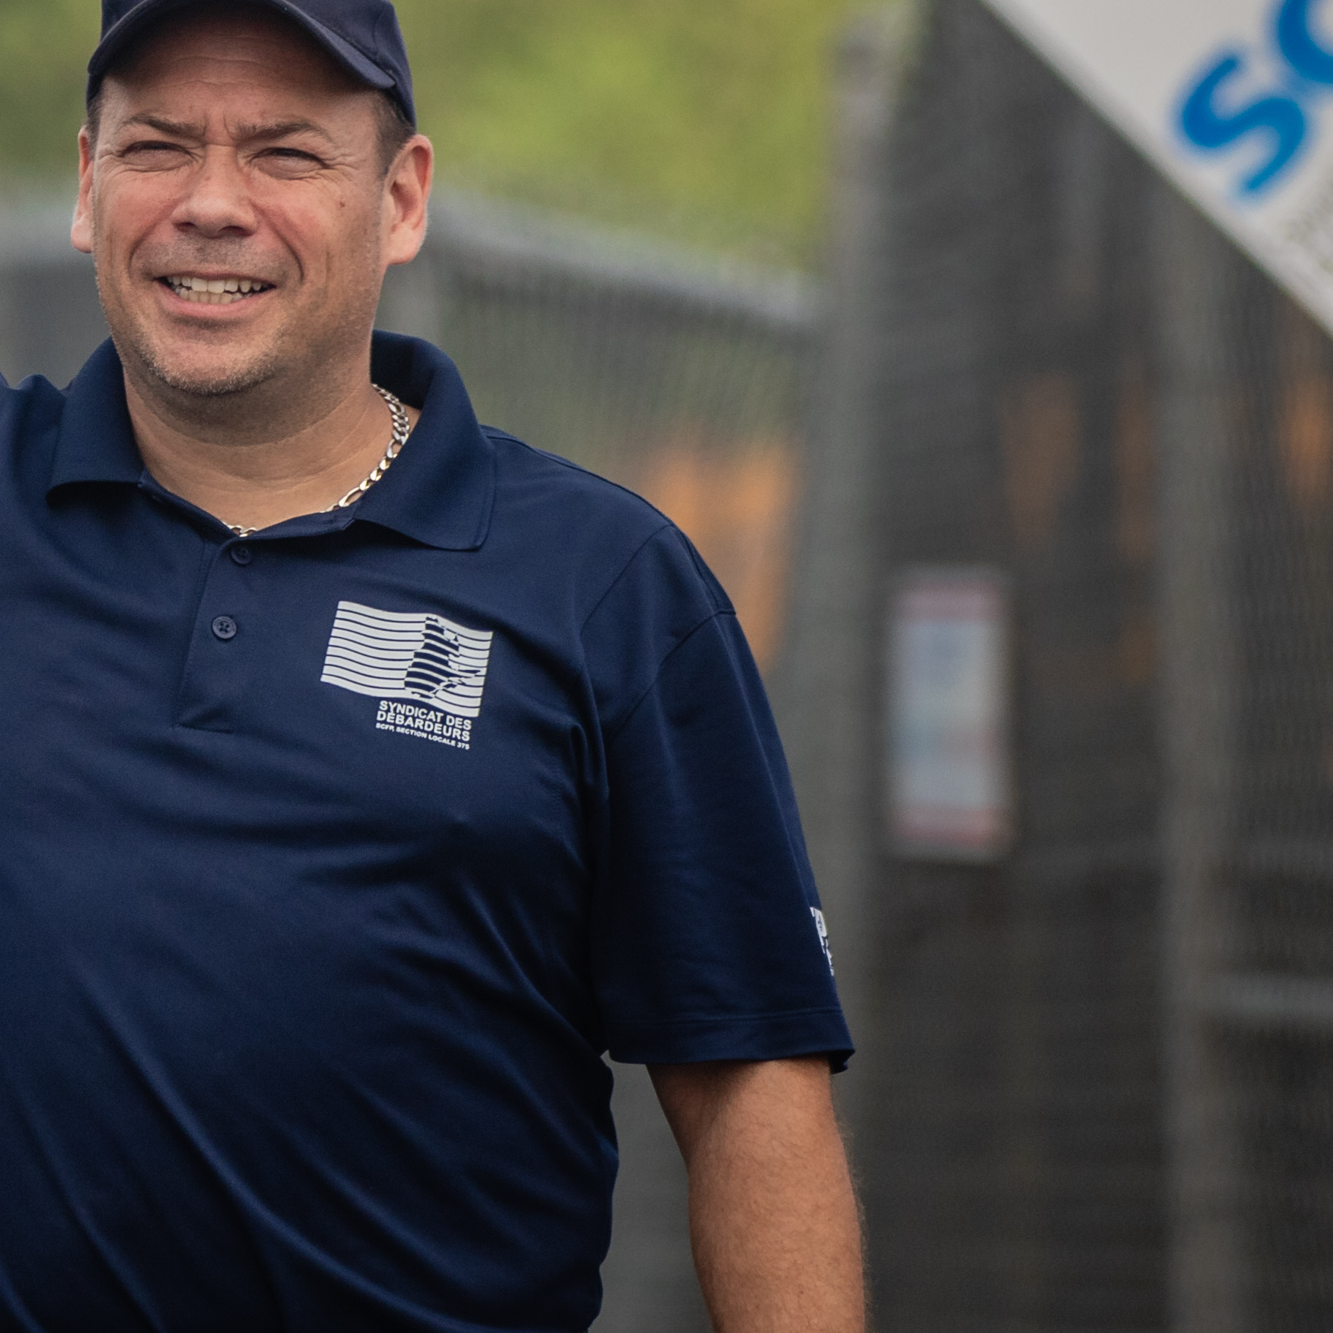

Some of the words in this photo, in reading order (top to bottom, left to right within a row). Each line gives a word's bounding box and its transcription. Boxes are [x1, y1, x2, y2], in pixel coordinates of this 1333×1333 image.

[379, 700, 444, 722] SYNDICAT
[445, 715, 472, 730] DES
[396, 727, 428, 738] SECTION
[428, 734, 456, 746] LOCALE
